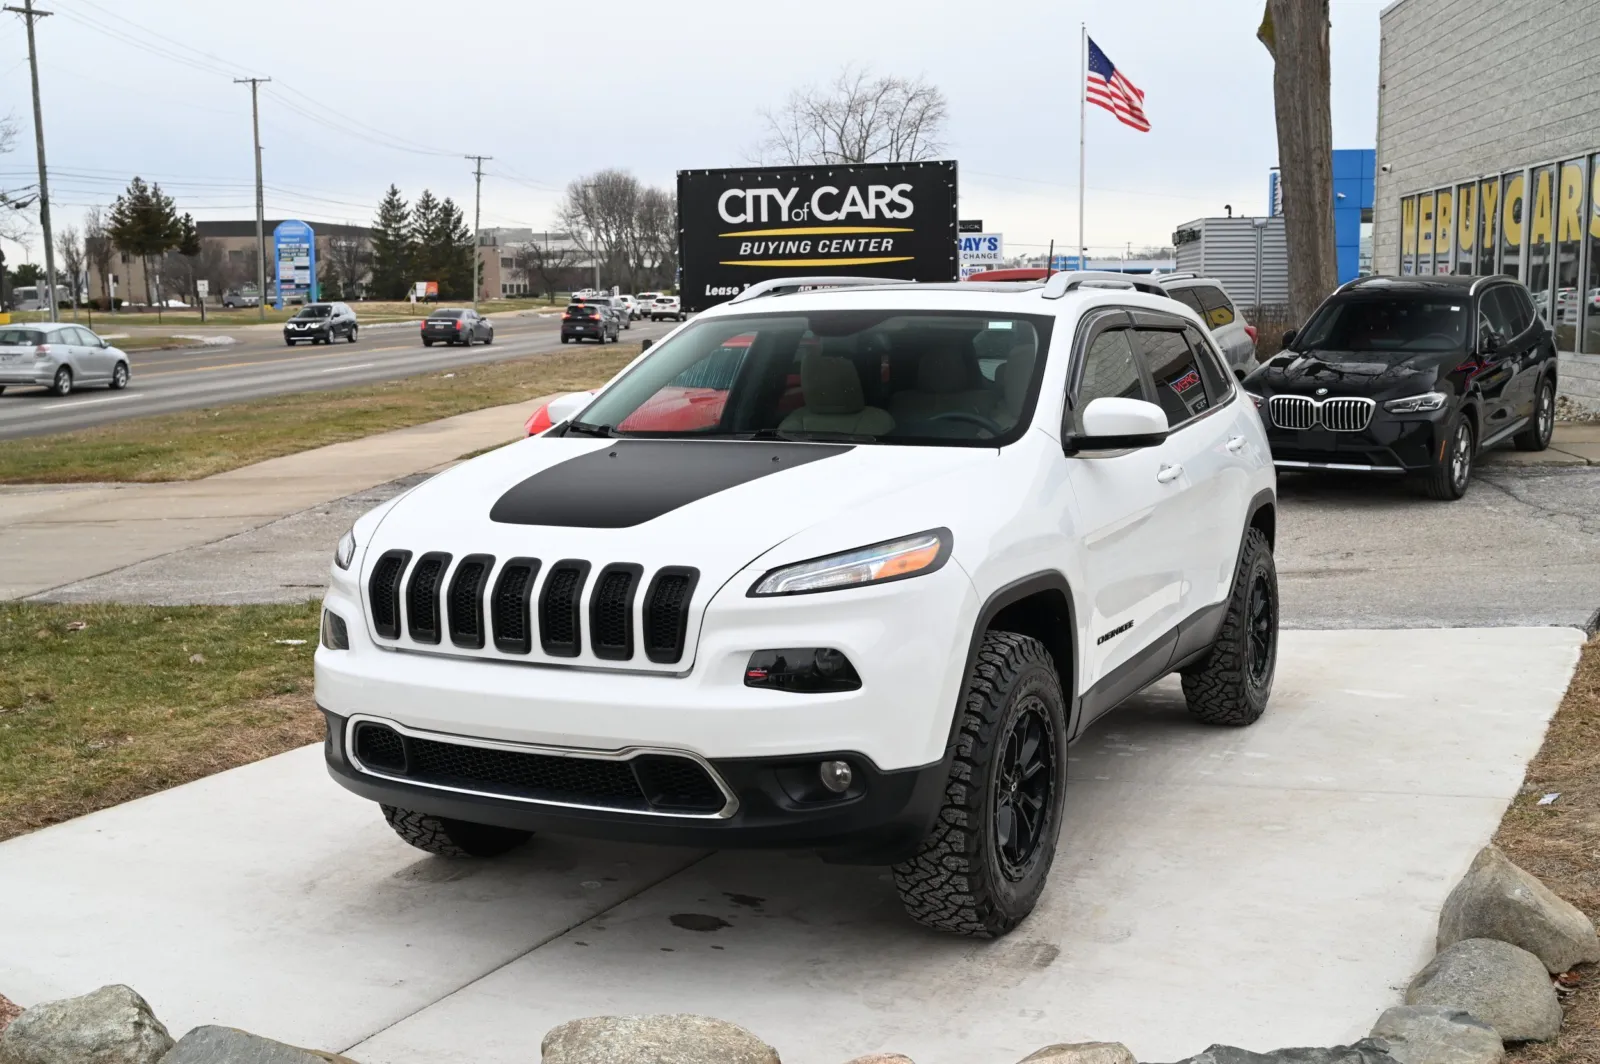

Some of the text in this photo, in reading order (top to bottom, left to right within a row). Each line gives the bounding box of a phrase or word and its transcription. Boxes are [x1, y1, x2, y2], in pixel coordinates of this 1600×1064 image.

[718, 183, 914, 224] CITY of CARS
[739, 238, 894, 255] BUYING CENTER
[705, 284, 740, 296] Lease
[1097, 619, 1134, 646] CHEROKEE
